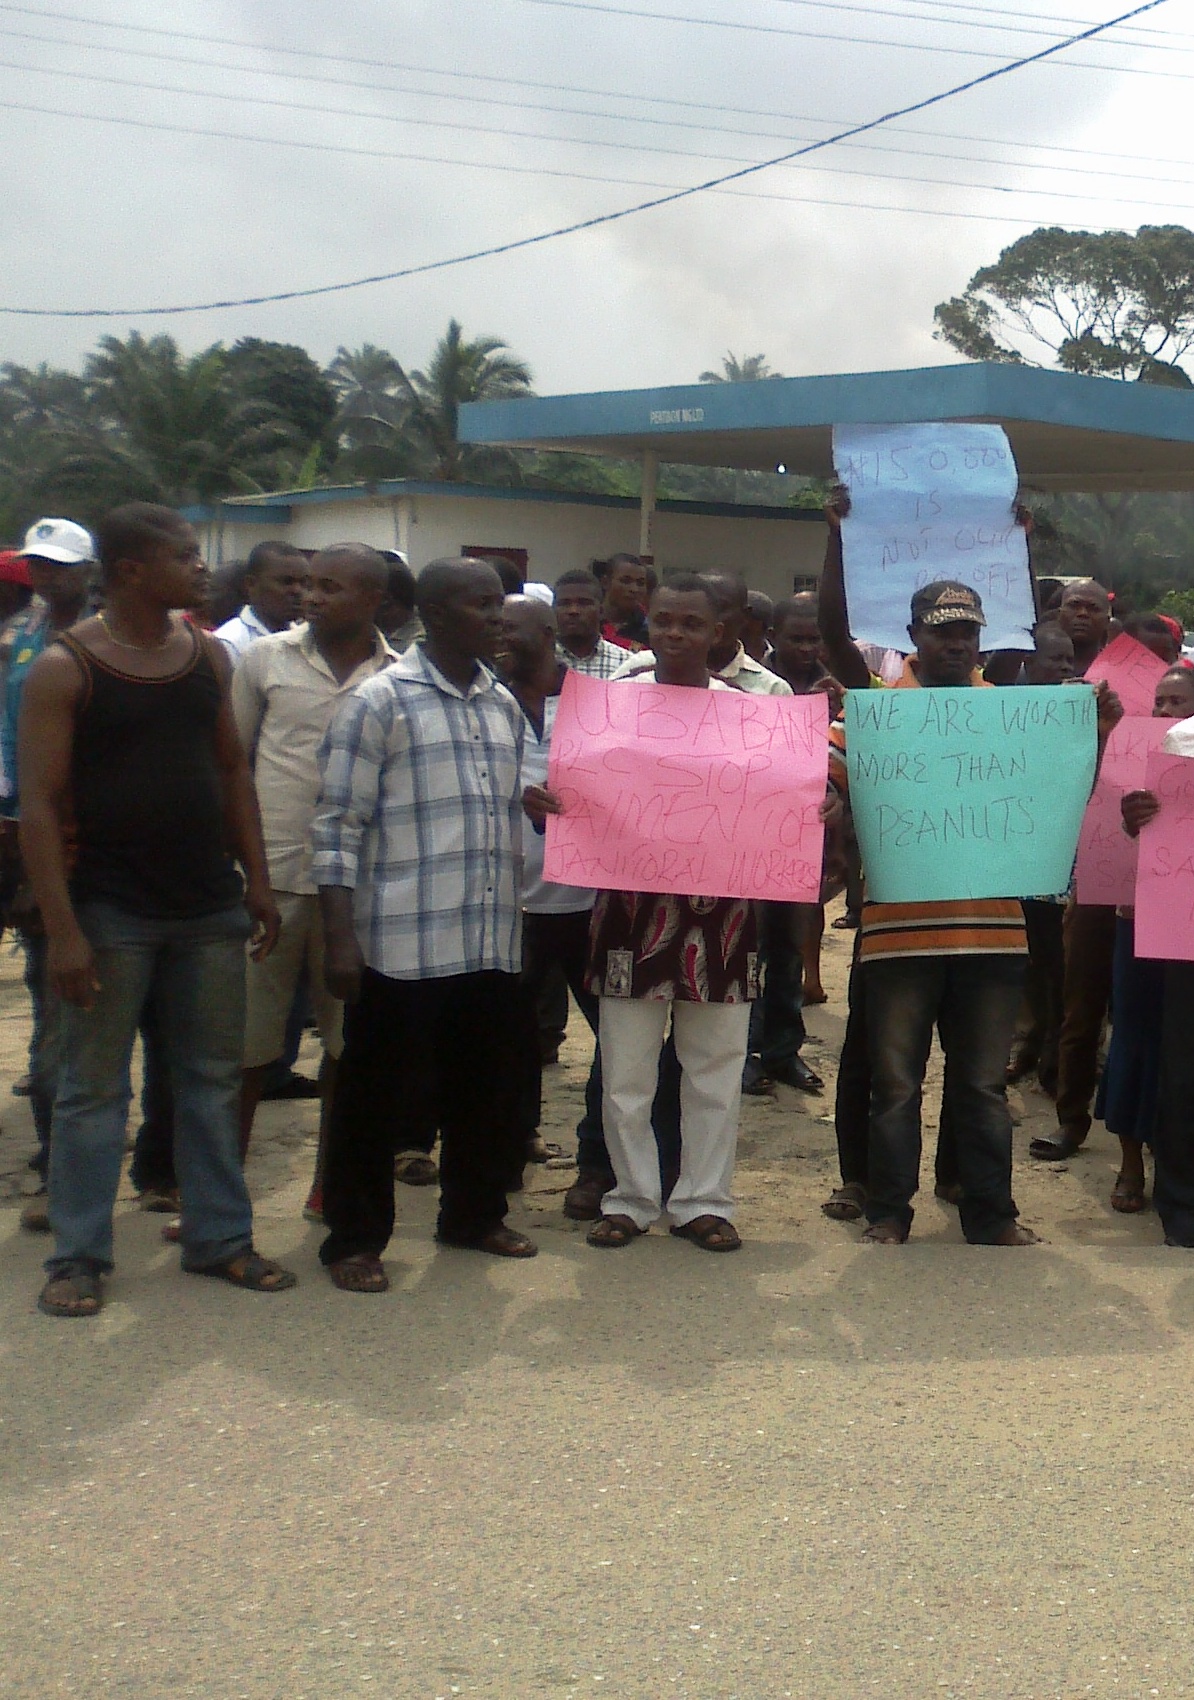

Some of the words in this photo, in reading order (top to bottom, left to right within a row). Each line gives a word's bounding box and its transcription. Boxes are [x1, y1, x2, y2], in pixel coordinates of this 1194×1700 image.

[739, 699, 829, 757] BANK
[854, 693, 901, 731] WE
[919, 692, 983, 736] ARE
[1001, 698, 1092, 735] WORTH
[556, 739, 631, 774] PLC
[653, 753, 772, 804] STOP
[856, 752, 928, 786] MORE
[941, 751, 1026, 787] THAN
[876, 796, 1035, 851] PEANUTS
